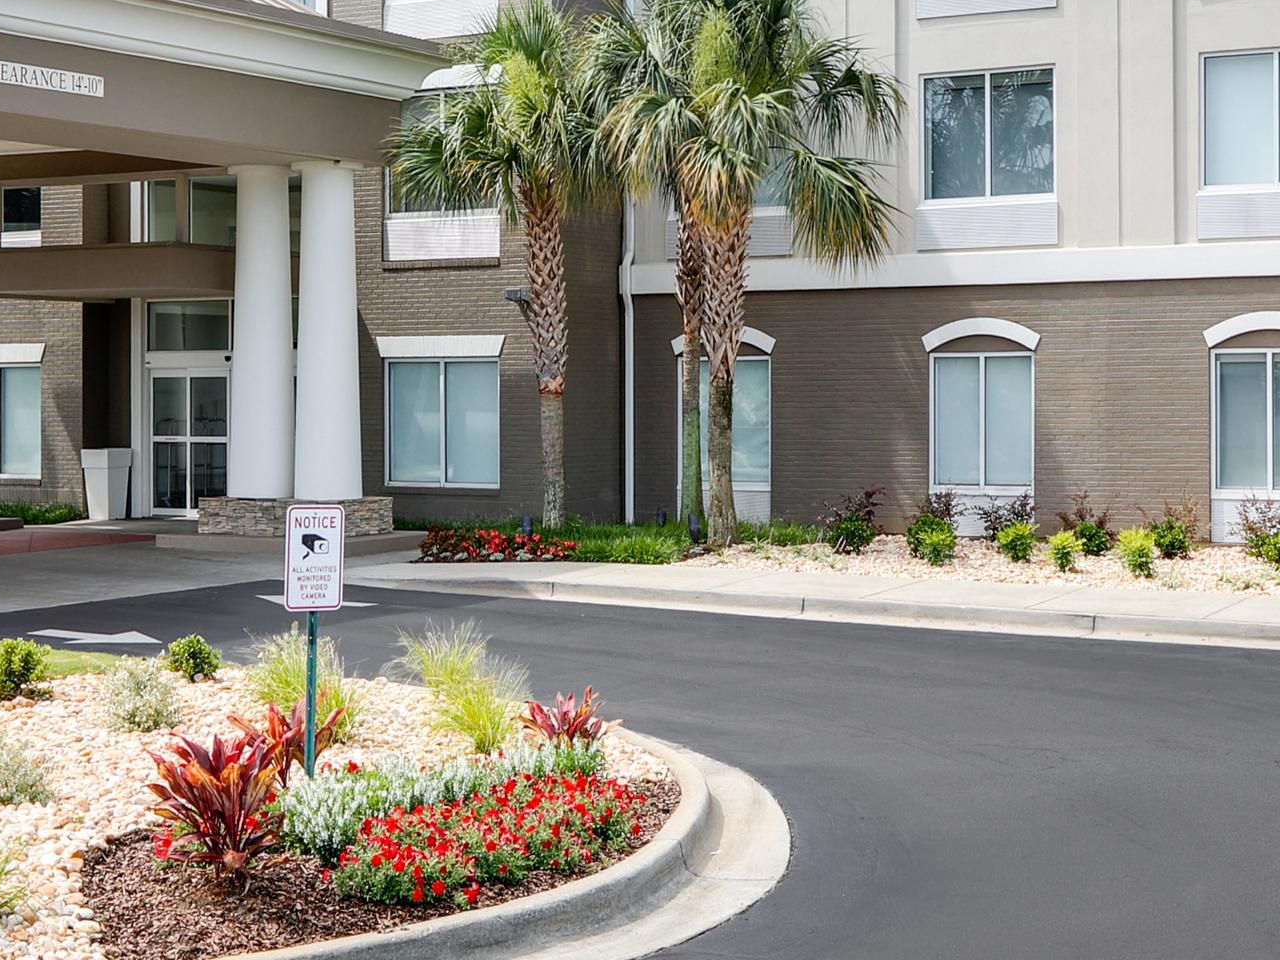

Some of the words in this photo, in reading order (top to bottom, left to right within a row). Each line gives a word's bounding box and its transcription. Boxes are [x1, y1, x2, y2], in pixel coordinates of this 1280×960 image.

[71, 74, 103, 95] 14'-10"
[294, 516, 337, 529] NOTICE
[305, 565, 337, 573] ACTIVITIES
[297, 574, 331, 582] MONITORED
[300, 583, 308, 591] BY
[310, 583, 328, 591] VIDEO
[301, 592, 326, 600] CAMERA
